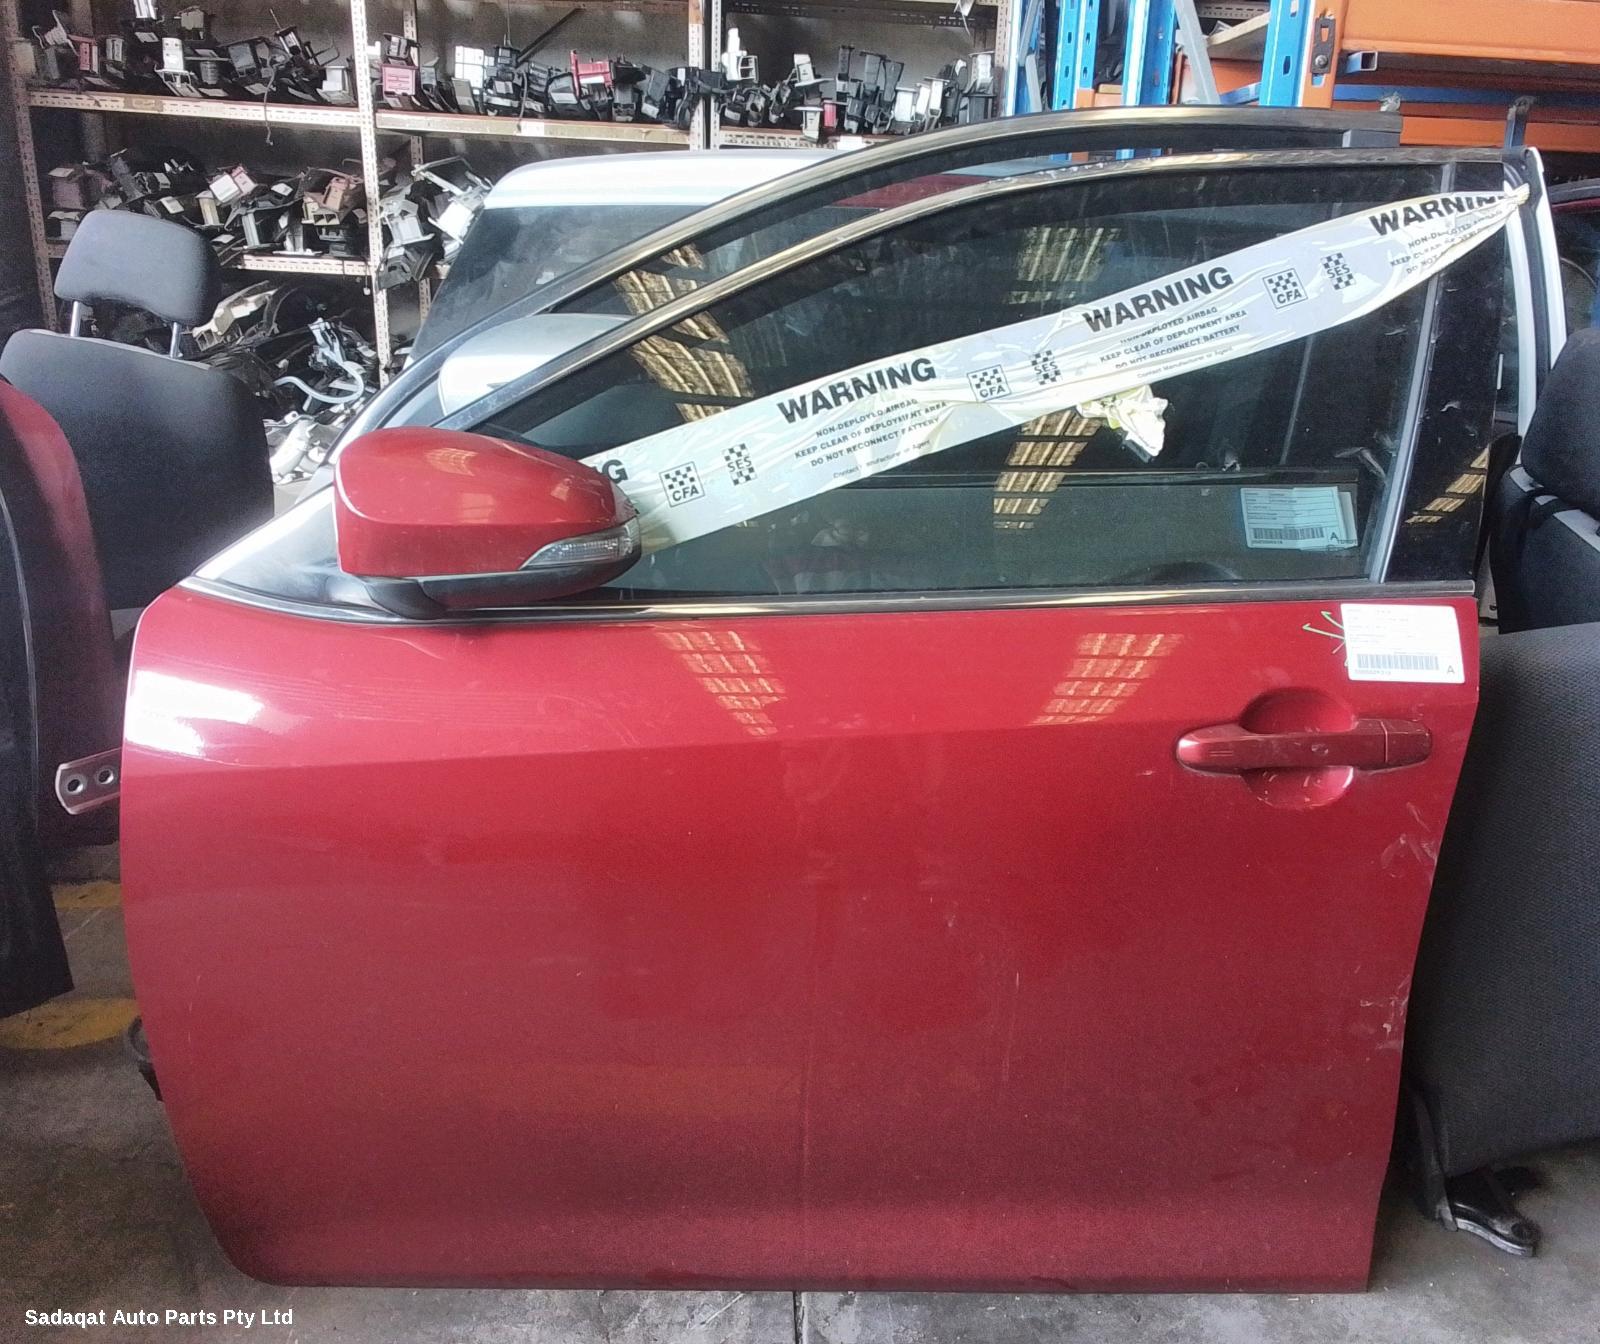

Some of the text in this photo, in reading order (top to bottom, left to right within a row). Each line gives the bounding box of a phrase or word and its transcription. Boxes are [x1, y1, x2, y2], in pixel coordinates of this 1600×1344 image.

[1369, 195, 1504, 236] WARNIN
[1327, 263, 1350, 279] SES
[1082, 266, 1234, 333] WARNING
[1276, 288, 1302, 304] CFA
[1186, 306, 1218, 322] AIRBAG
[1100, 310, 1248, 363] KEEP CLEAR OF DEPLOYMENT AREA
[1150, 338, 1201, 359] RECONNECT
[1203, 324, 1241, 343] BATTERY
[1034, 361, 1058, 375] SES
[776, 358, 936, 424] WARNING
[980, 385, 1005, 398] CFA
[794, 445, 818, 459] KEEP
[820, 435, 849, 451] CLEAR
[850, 430, 863, 440] OF
[924, 401, 947, 415] AREA
[810, 457, 824, 467] DO
[826, 449, 845, 462] NOT
[846, 431, 899, 455] RECONNECT
[727, 456, 752, 473] SES
[672, 485, 700, 502] CFA
[1447, 665, 1455, 674] A
